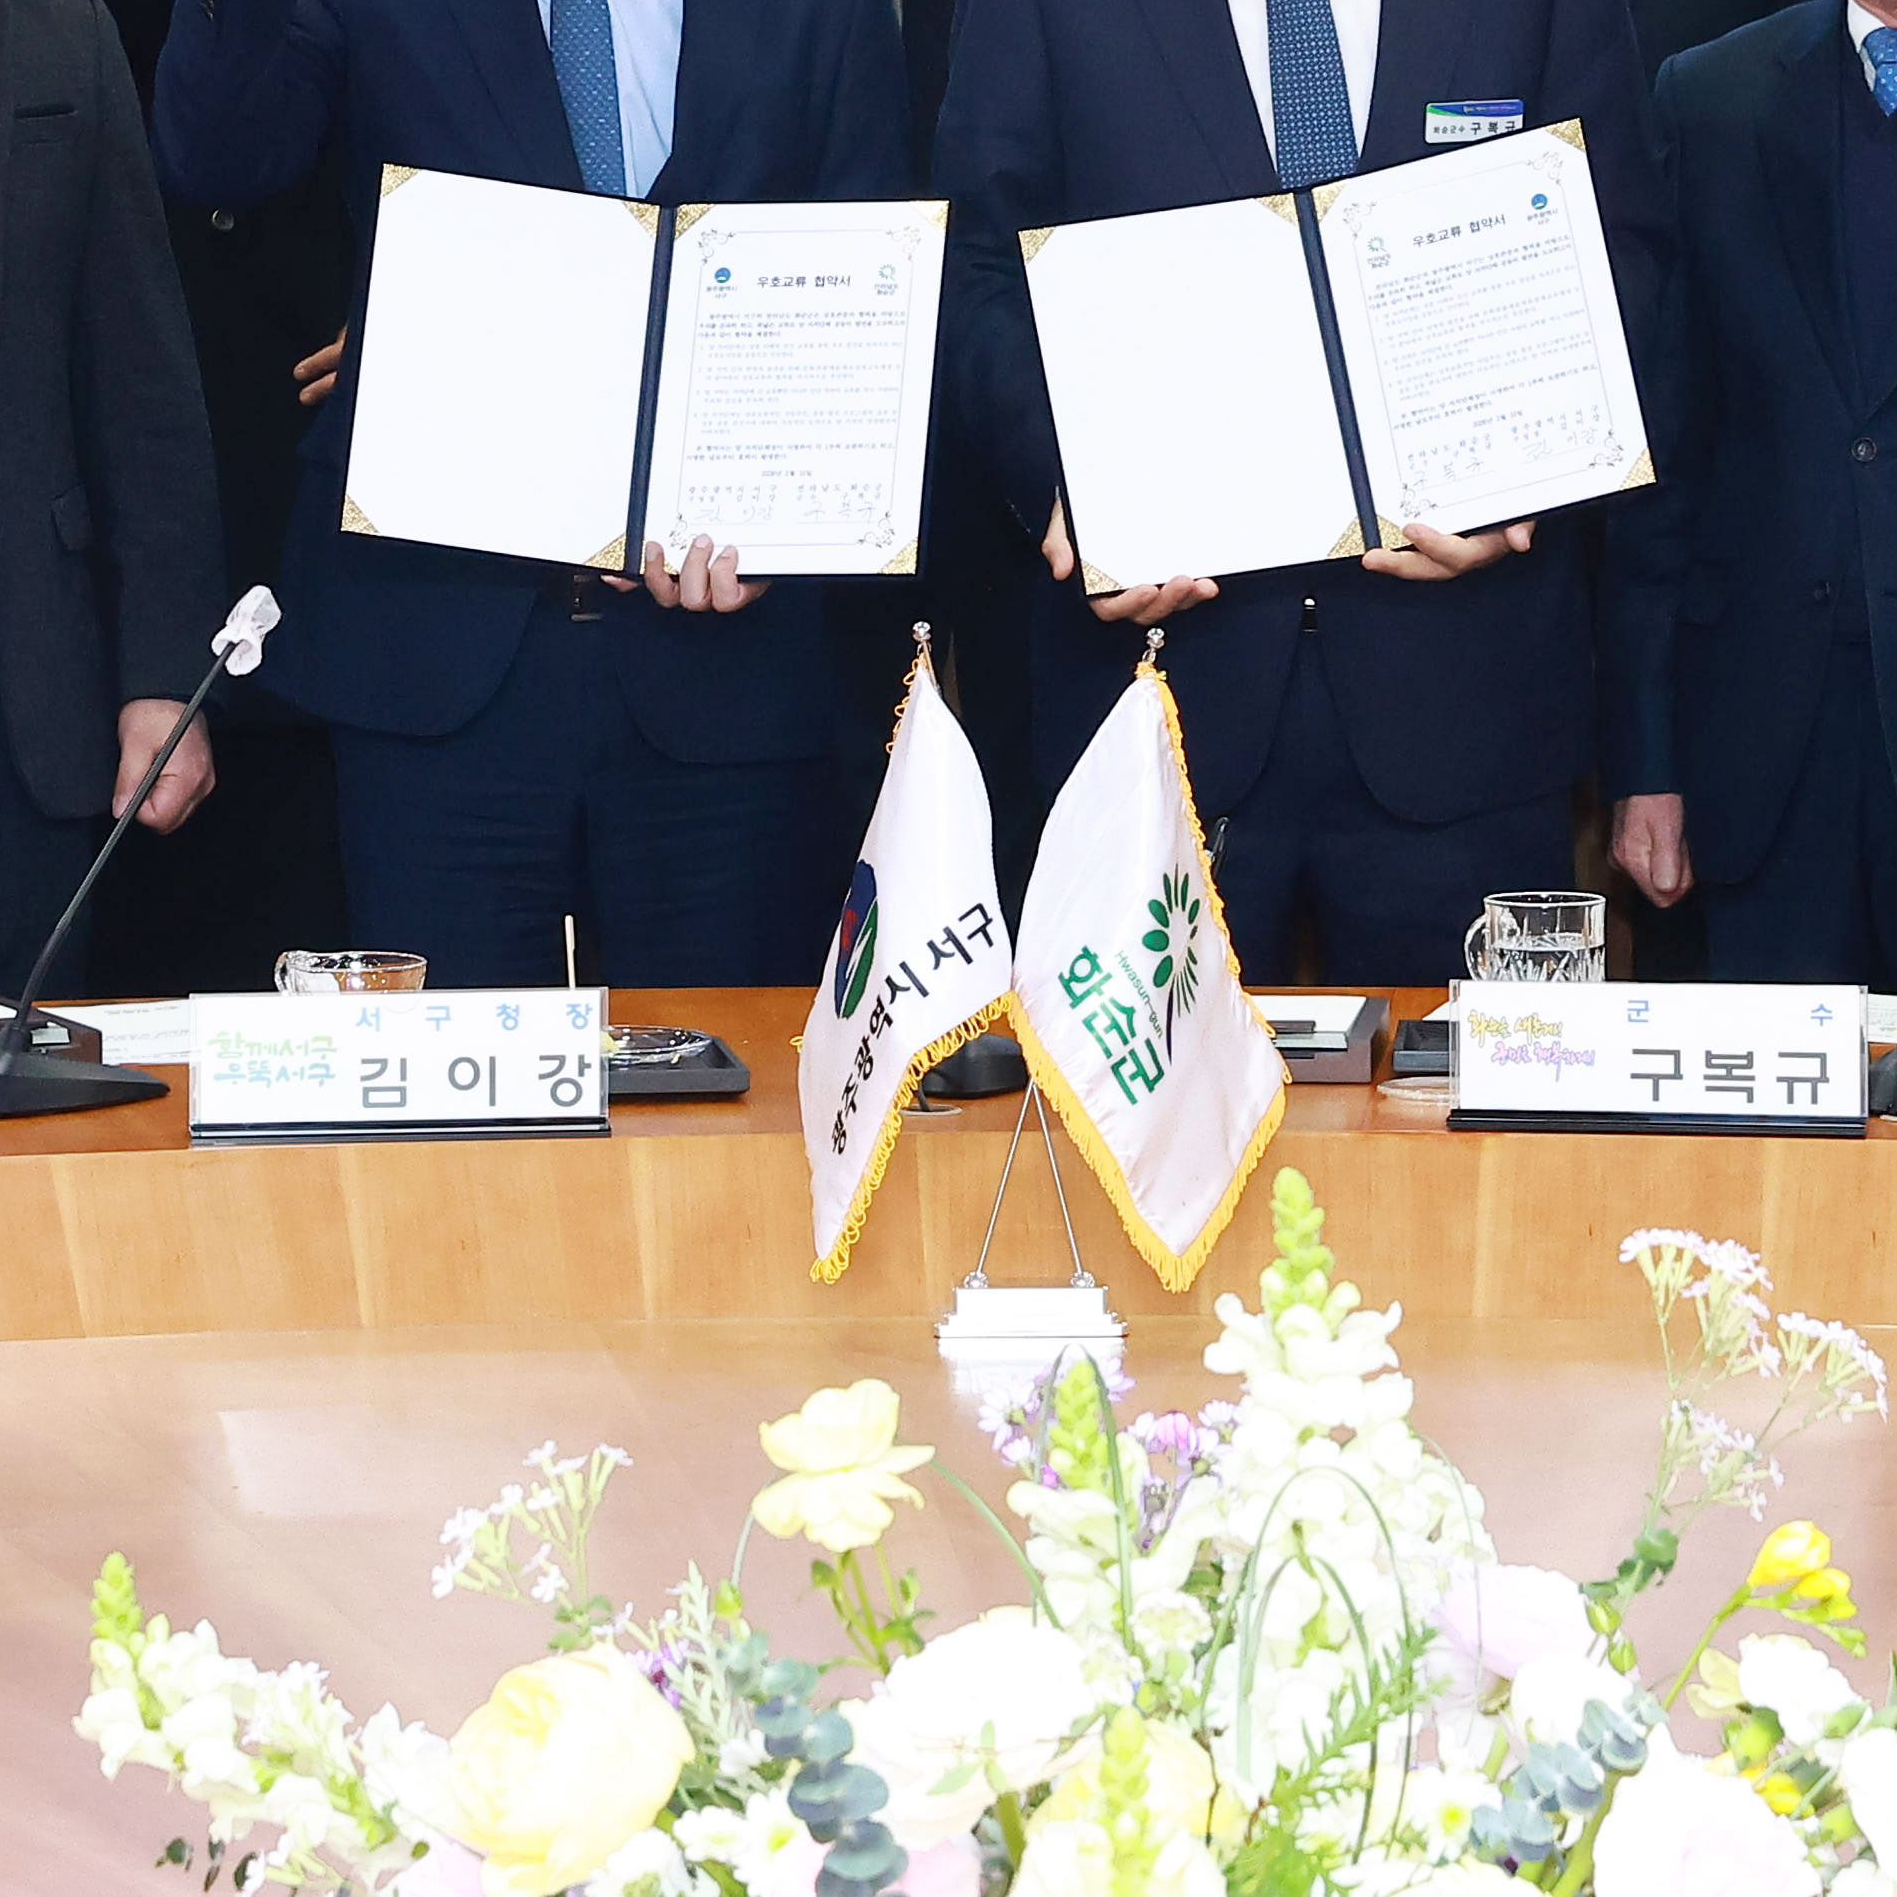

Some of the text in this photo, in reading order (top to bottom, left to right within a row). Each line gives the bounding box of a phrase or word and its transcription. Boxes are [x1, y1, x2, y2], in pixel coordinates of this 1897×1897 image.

[831, 902, 994, 1156] 광주광역시 서구
[1057, 943, 1166, 1106] 화순군
